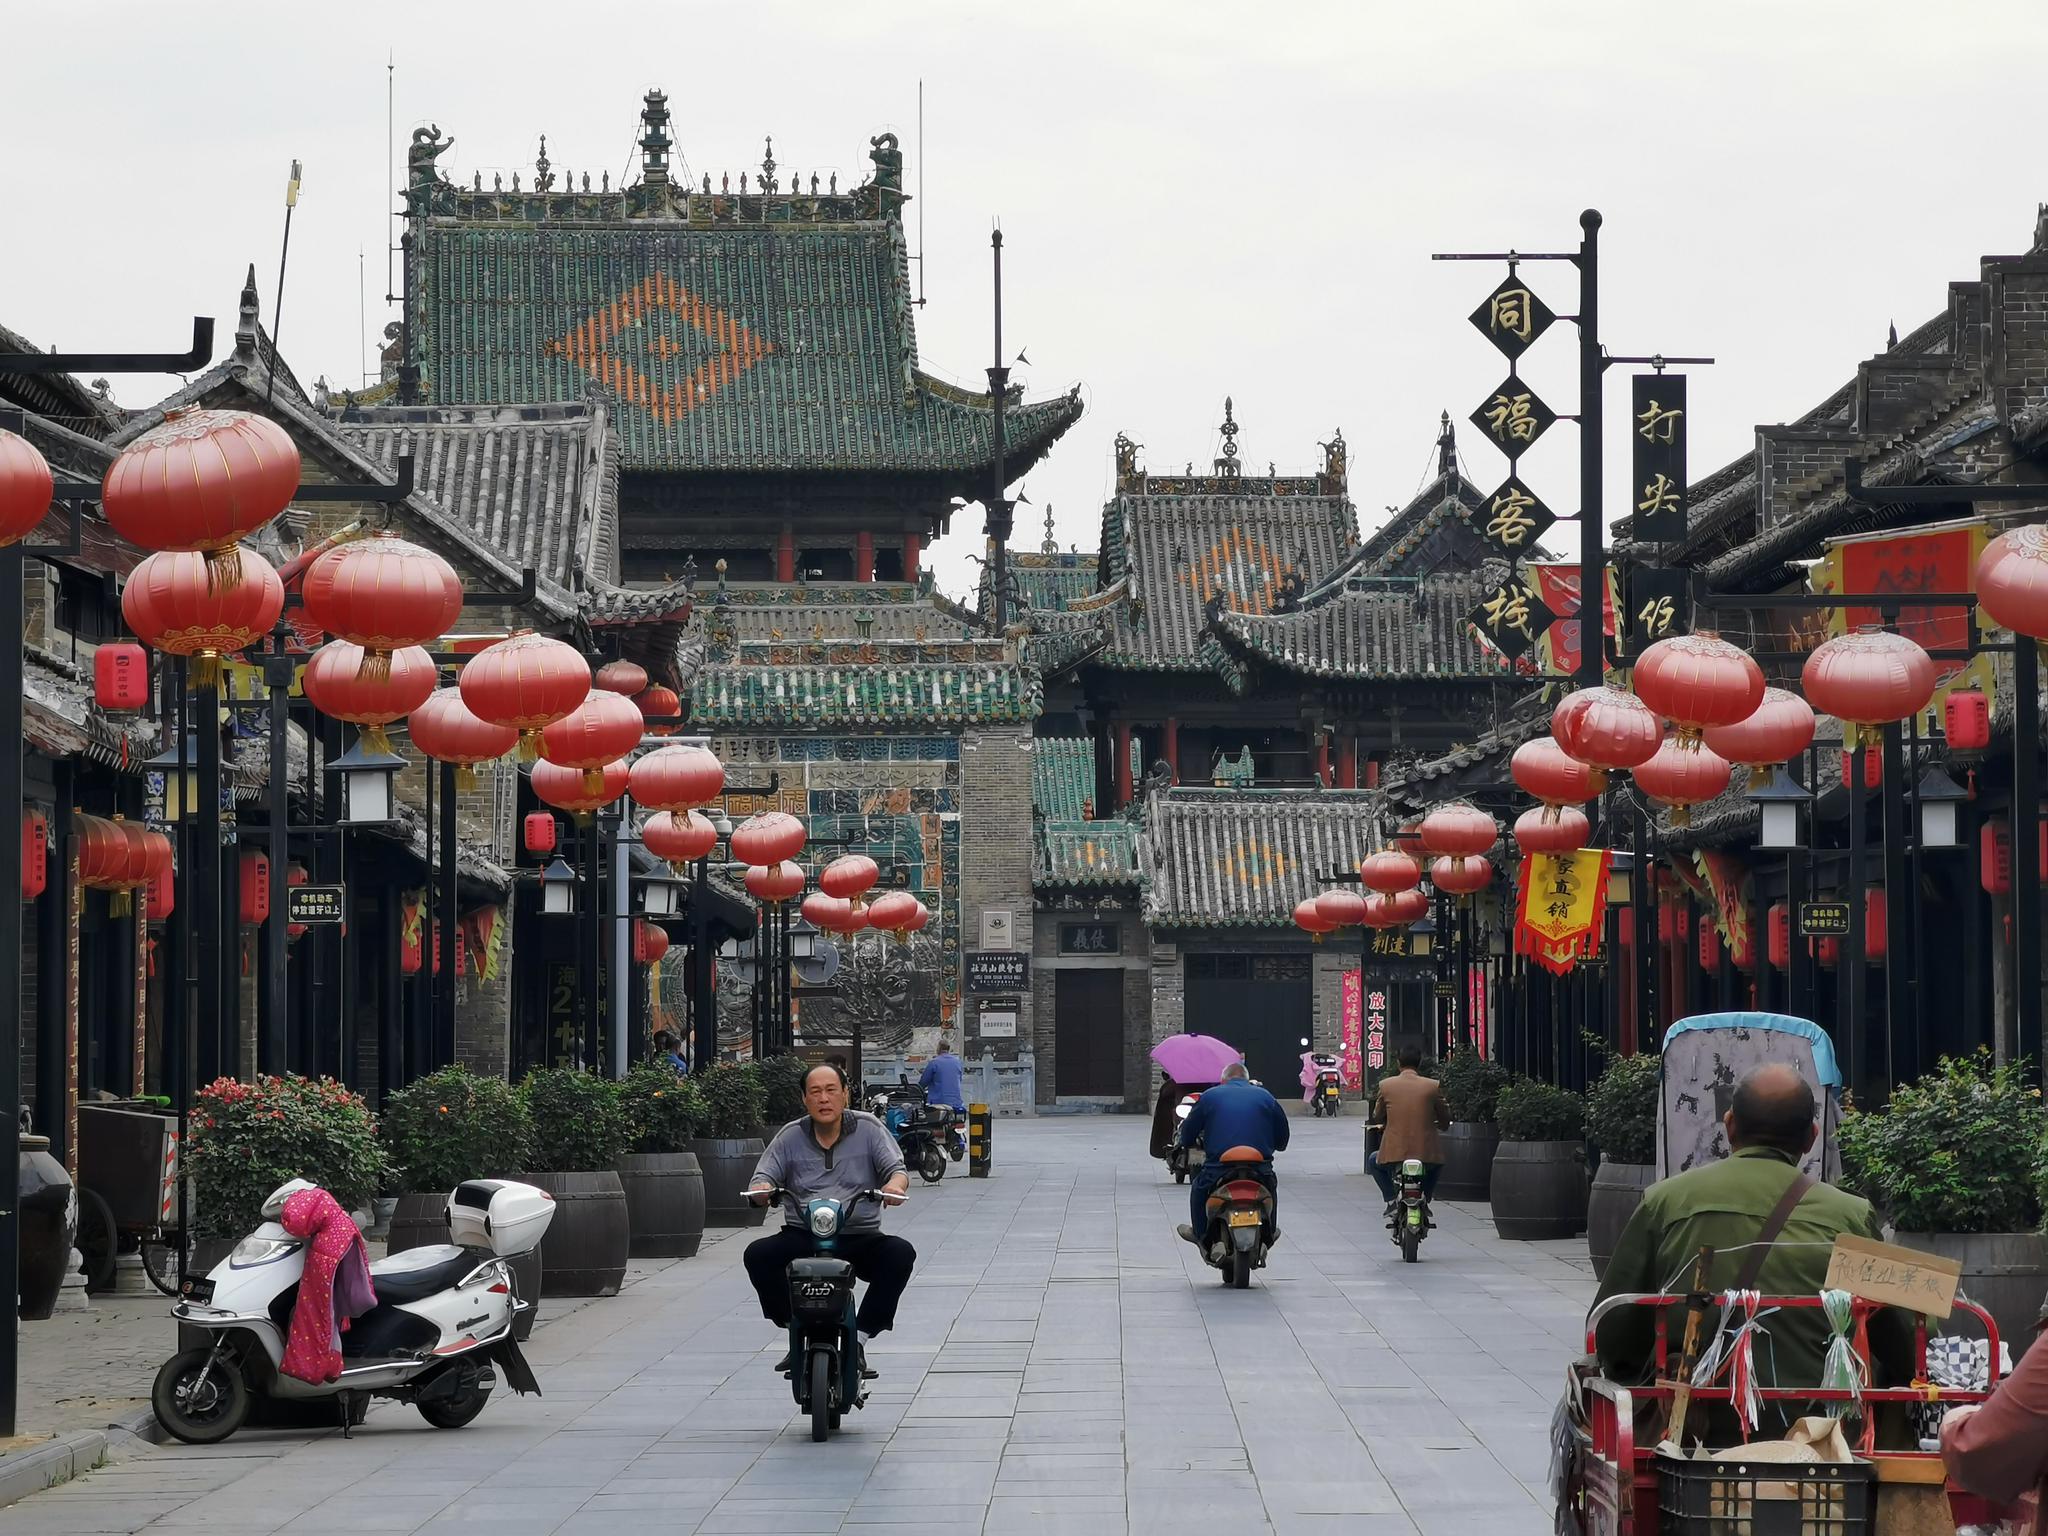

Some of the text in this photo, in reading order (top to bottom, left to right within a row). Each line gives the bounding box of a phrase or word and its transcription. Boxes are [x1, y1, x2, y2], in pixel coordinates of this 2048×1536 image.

[1483, 288, 1538, 641] 同福客栈
[1636, 399, 1683, 517] 打尖
[1367, 991, 1386, 1070] 放大复印
